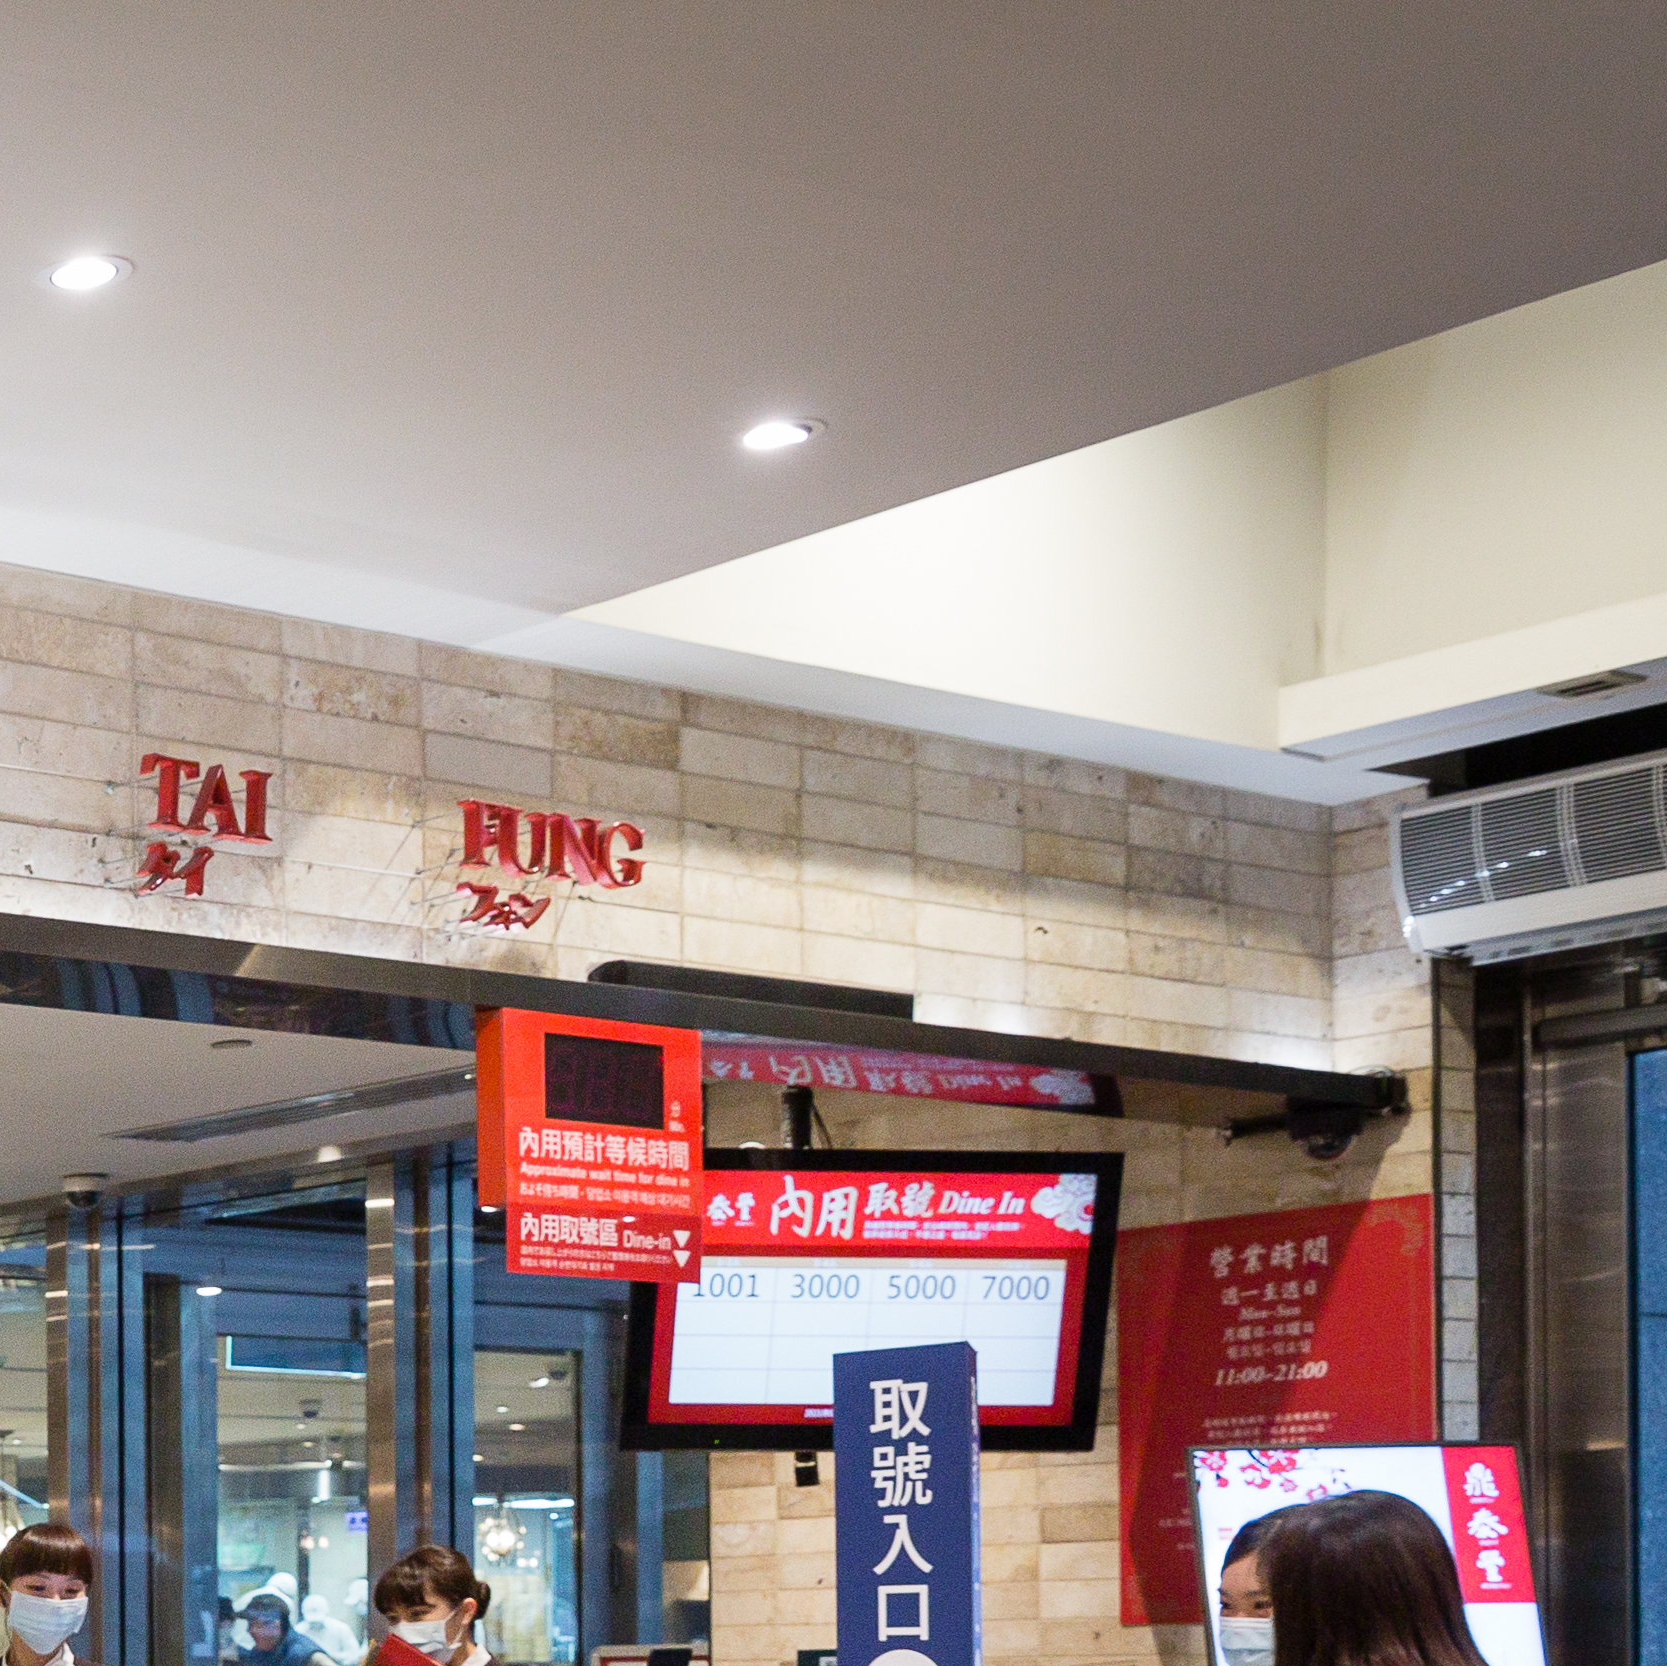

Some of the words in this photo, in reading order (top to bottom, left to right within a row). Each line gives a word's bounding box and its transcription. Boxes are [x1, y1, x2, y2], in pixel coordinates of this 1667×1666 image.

[140, 752, 273, 845] TAI
[457, 797, 646, 891] FUNG
[137, 840, 214, 899] タイ
[519, 1126, 690, 1172] 內用預計等候時間
[520, 1161, 587, 1177] Approximate
[589, 1169, 612, 1181] wait
[613, 1170, 637, 1183] time
[638, 1171, 654, 1184] for
[655, 1173, 678, 1187] dine
[679, 1176, 690, 1187] in
[520, 1212, 618, 1247] 內用取號區
[622, 1229, 672, 1250] Dine-in
[707, 1193, 755, 1221] 泰豐
[770, 1175, 858, 1239] 內用
[865, 1180, 934, 1218] 取號
[937, 1190, 995, 1214] Dine
[997, 1191, 1025, 1215] In
[1210, 1235, 1328, 1279] 營業時間
[791, 1273, 859, 1299] 3000
[888, 1275, 955, 1300] 5000
[983, 1275, 1050, 1300] 7000
[869, 1379, 933, 1642] 取號入口
[1463, 1462, 1509, 1583] 鼎泰豐
